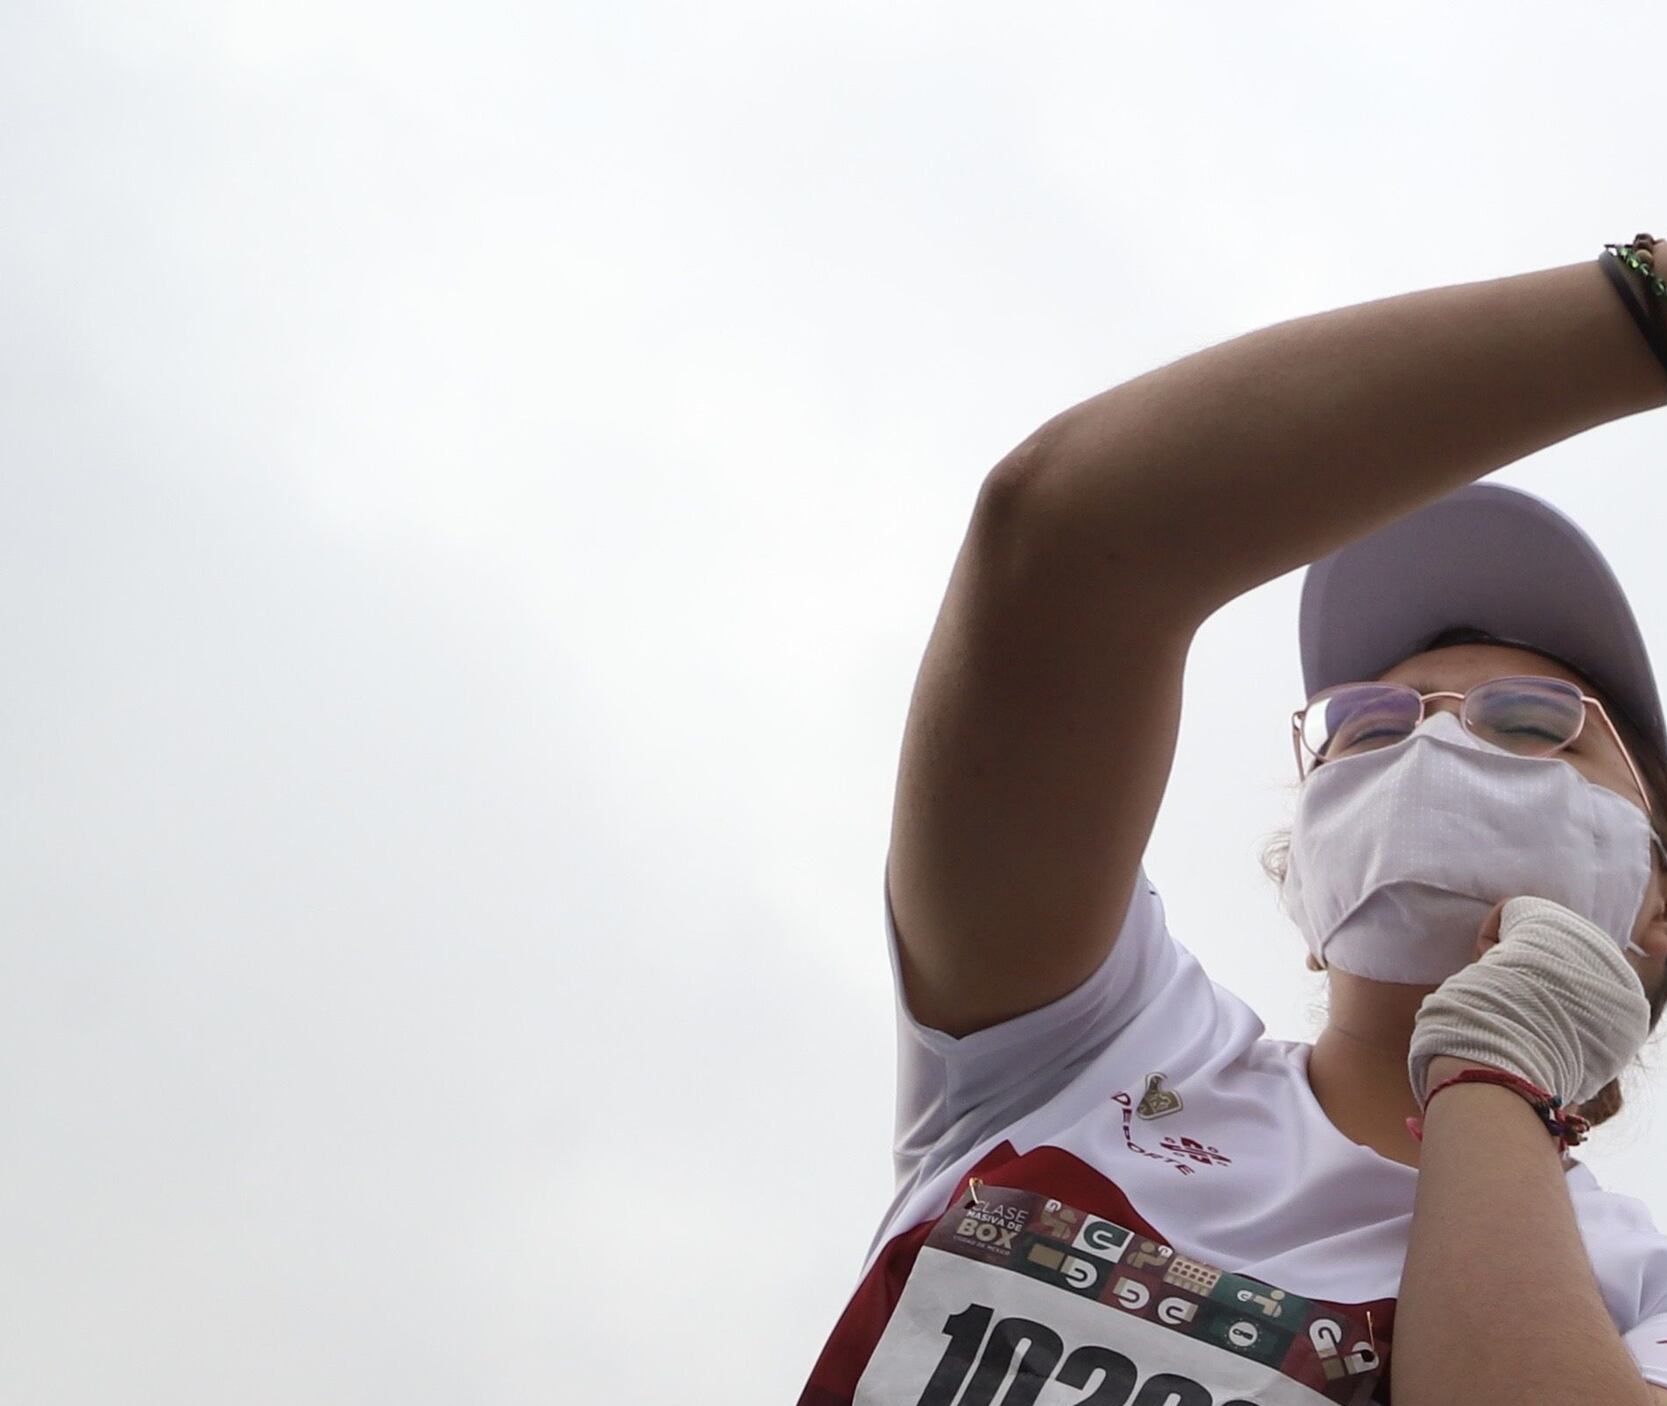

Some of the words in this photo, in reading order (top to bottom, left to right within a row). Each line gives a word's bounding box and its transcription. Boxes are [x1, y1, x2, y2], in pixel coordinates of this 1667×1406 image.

[966, 1209, 1005, 1227] MASIVA
[1007, 1221, 1024, 1233] DE
[971, 1200, 1029, 1224] CLASE
[956, 1217, 1018, 1250] BOX
